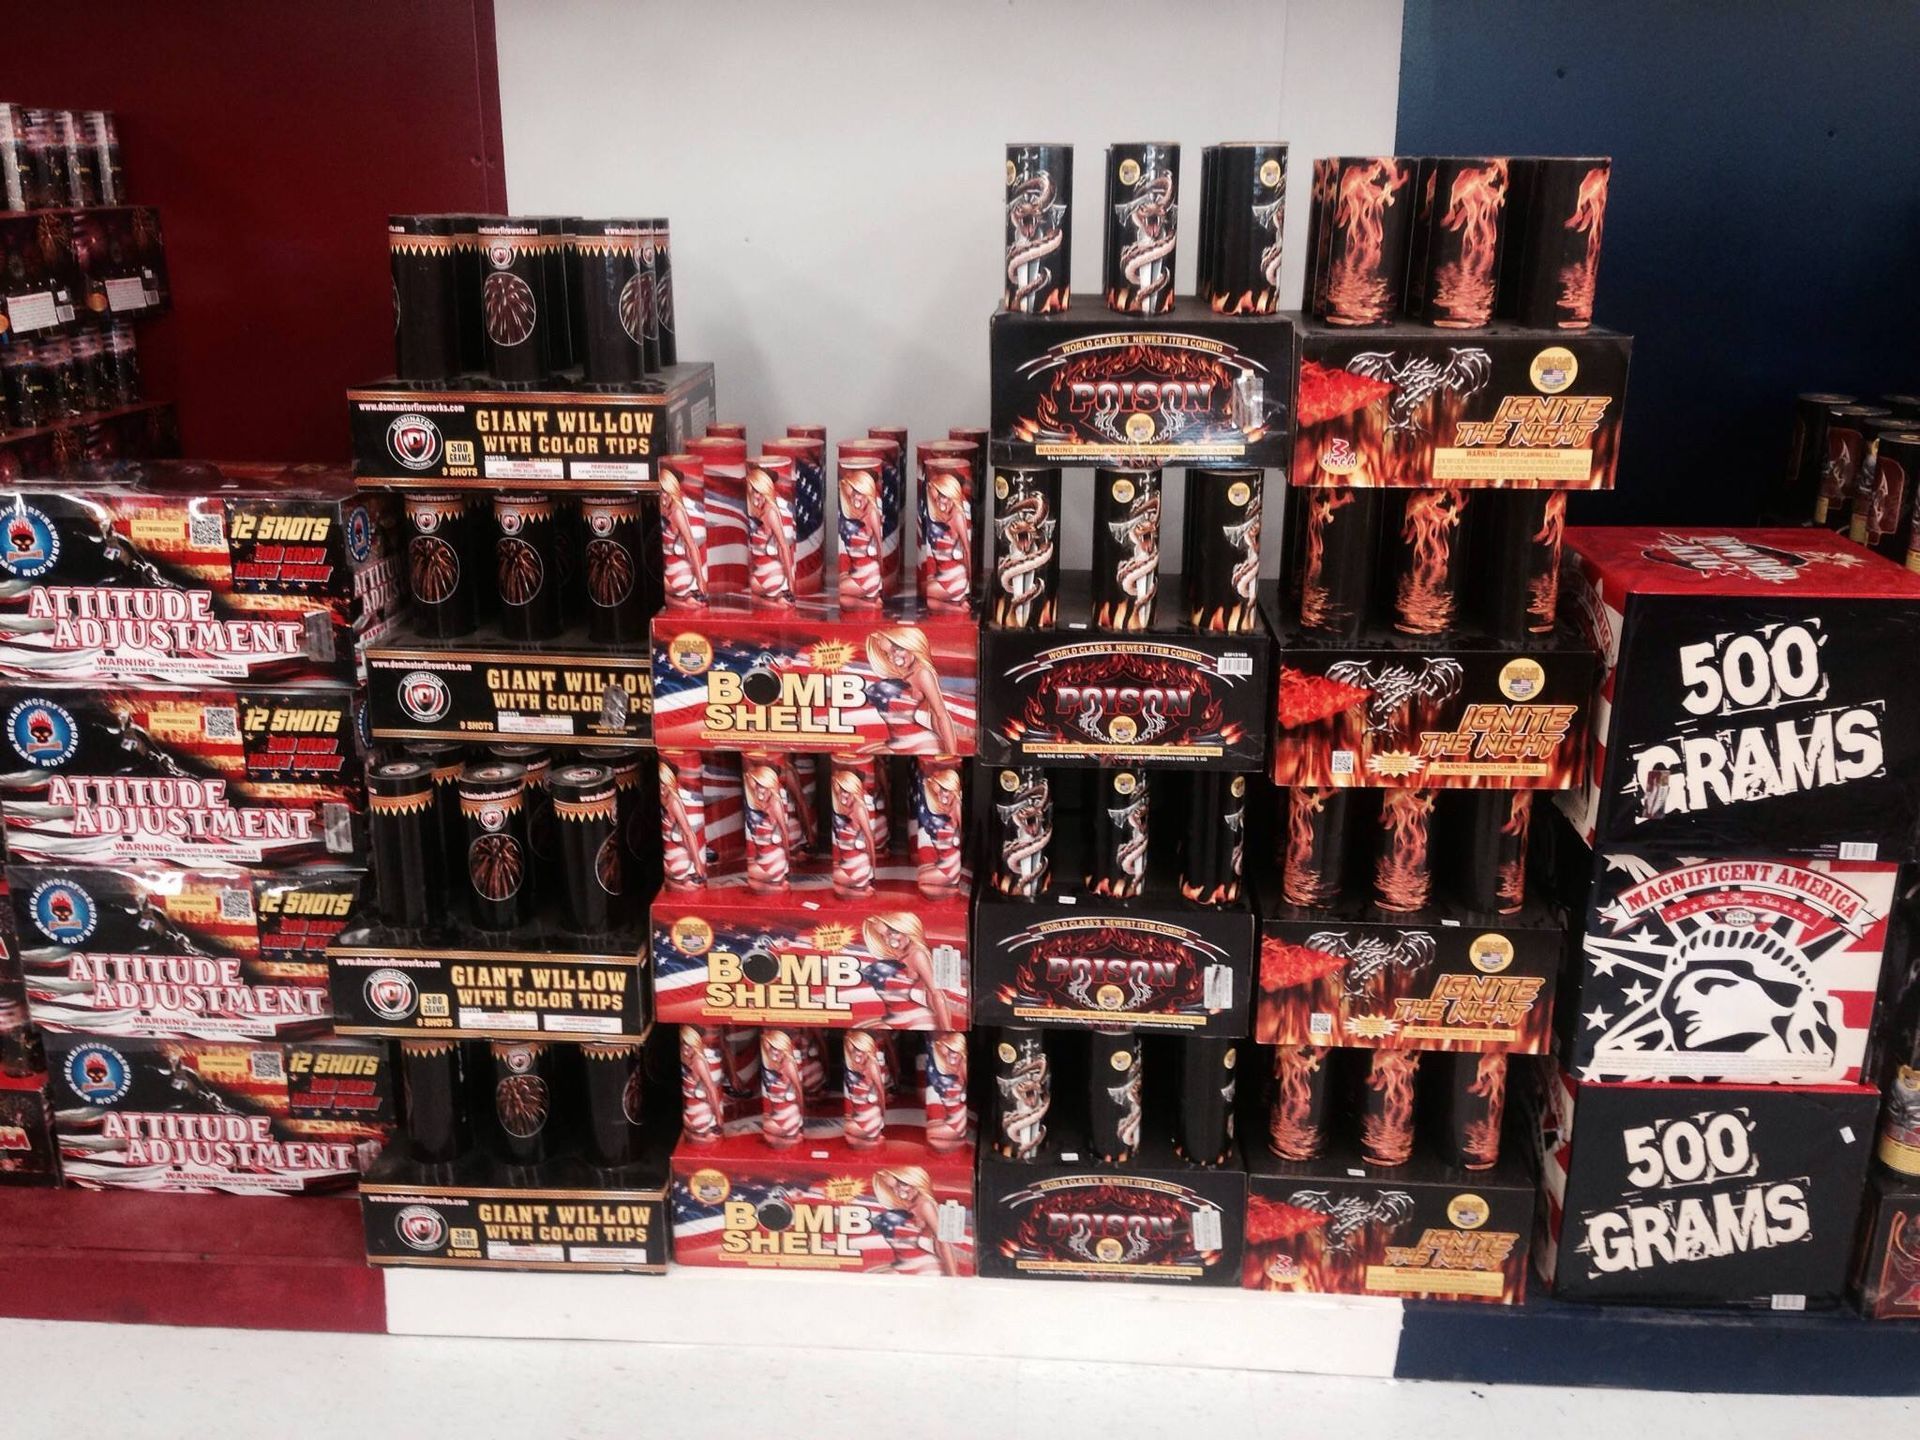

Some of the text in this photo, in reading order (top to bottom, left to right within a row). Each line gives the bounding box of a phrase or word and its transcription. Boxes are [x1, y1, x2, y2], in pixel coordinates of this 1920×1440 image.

[1062, 335, 1223, 353] WORLD CLASS'S NEWEST ITEM COMING
[358, 403, 465, 413] www.dominatorfireworks.com
[1070, 381, 1213, 413] POISON
[1494, 395, 1613, 424] IGNITE
[392, 415, 435, 431] DOMINATOR
[476, 410, 654, 434] GIANT WILLOW
[1453, 422, 1600, 447] THE NIGHT
[449, 453, 471, 463] GRAMS
[451, 443, 468, 453] 500
[482, 435, 650, 455] WITH COLOR TIPS
[442, 467, 478, 477] 9 SHOTS
[231, 514, 331, 541] 12 SHOTS
[28, 587, 214, 622] ATTITUDE
[53, 618, 303, 654] ADJUSTMENT
[97, 657, 155, 667] WARNING
[1048, 644, 1202, 661] WORLD CLASS'S NEWEST ITEM COMING
[487, 669, 557, 691] GIANT
[1680, 625, 1819, 715] 500
[493, 692, 603, 713] WITH COLOR
[1055, 686, 1192, 716] POISON
[244, 708, 342, 732] 12 SHOTS
[460, 721, 466, 730] 9
[467, 721, 494, 731] SHOTS
[704, 704, 855, 733] SHELL
[1459, 704, 1577, 733] IGNITE
[1419, 732, 1565, 758] THE NIGHT
[1634, 708, 1884, 815] GRAMS
[49, 776, 228, 810] ATTITUDE
[73, 805, 315, 840] ADJUSTMENT
[115, 843, 172, 851] WARNING
[1627, 864, 1860, 916] MAGNIFICENT AMERICA
[259, 893, 353, 916] 12 SHOTS
[1040, 921, 1067, 932] WORLD
[1104, 920, 1137, 928] NEWEST
[1138, 920, 1156, 929] ITEM
[1157, 922, 1188, 937] COMING
[68, 952, 243, 986] ATTITUDE
[451, 966, 627, 991] GIANT WILLOW
[1047, 957, 1178, 986] POISON
[93, 981, 328, 1015] ADJUSTMENT
[457, 989, 624, 1010] WITH COLOR TIPS
[705, 983, 852, 1010] SHELL
[1429, 974, 1546, 1002] IGNITE
[133, 1017, 189, 1026] WARNING
[1394, 998, 1534, 1025] THE NIGHT
[289, 1053, 380, 1076] 12 SHOTS
[102, 1112, 274, 1143] ATTITUDE
[126, 1138, 357, 1170] ADJUSTMENT
[1623, 1113, 1750, 1188] 500
[478, 1205, 651, 1225] GIANT WILLOW
[1048, 1213, 1173, 1240] POISON
[1587, 1184, 1810, 1272] GRAMS
[484, 1225, 647, 1242] WITH COLOR TIPS
[721, 1230, 862, 1257] SHELL
